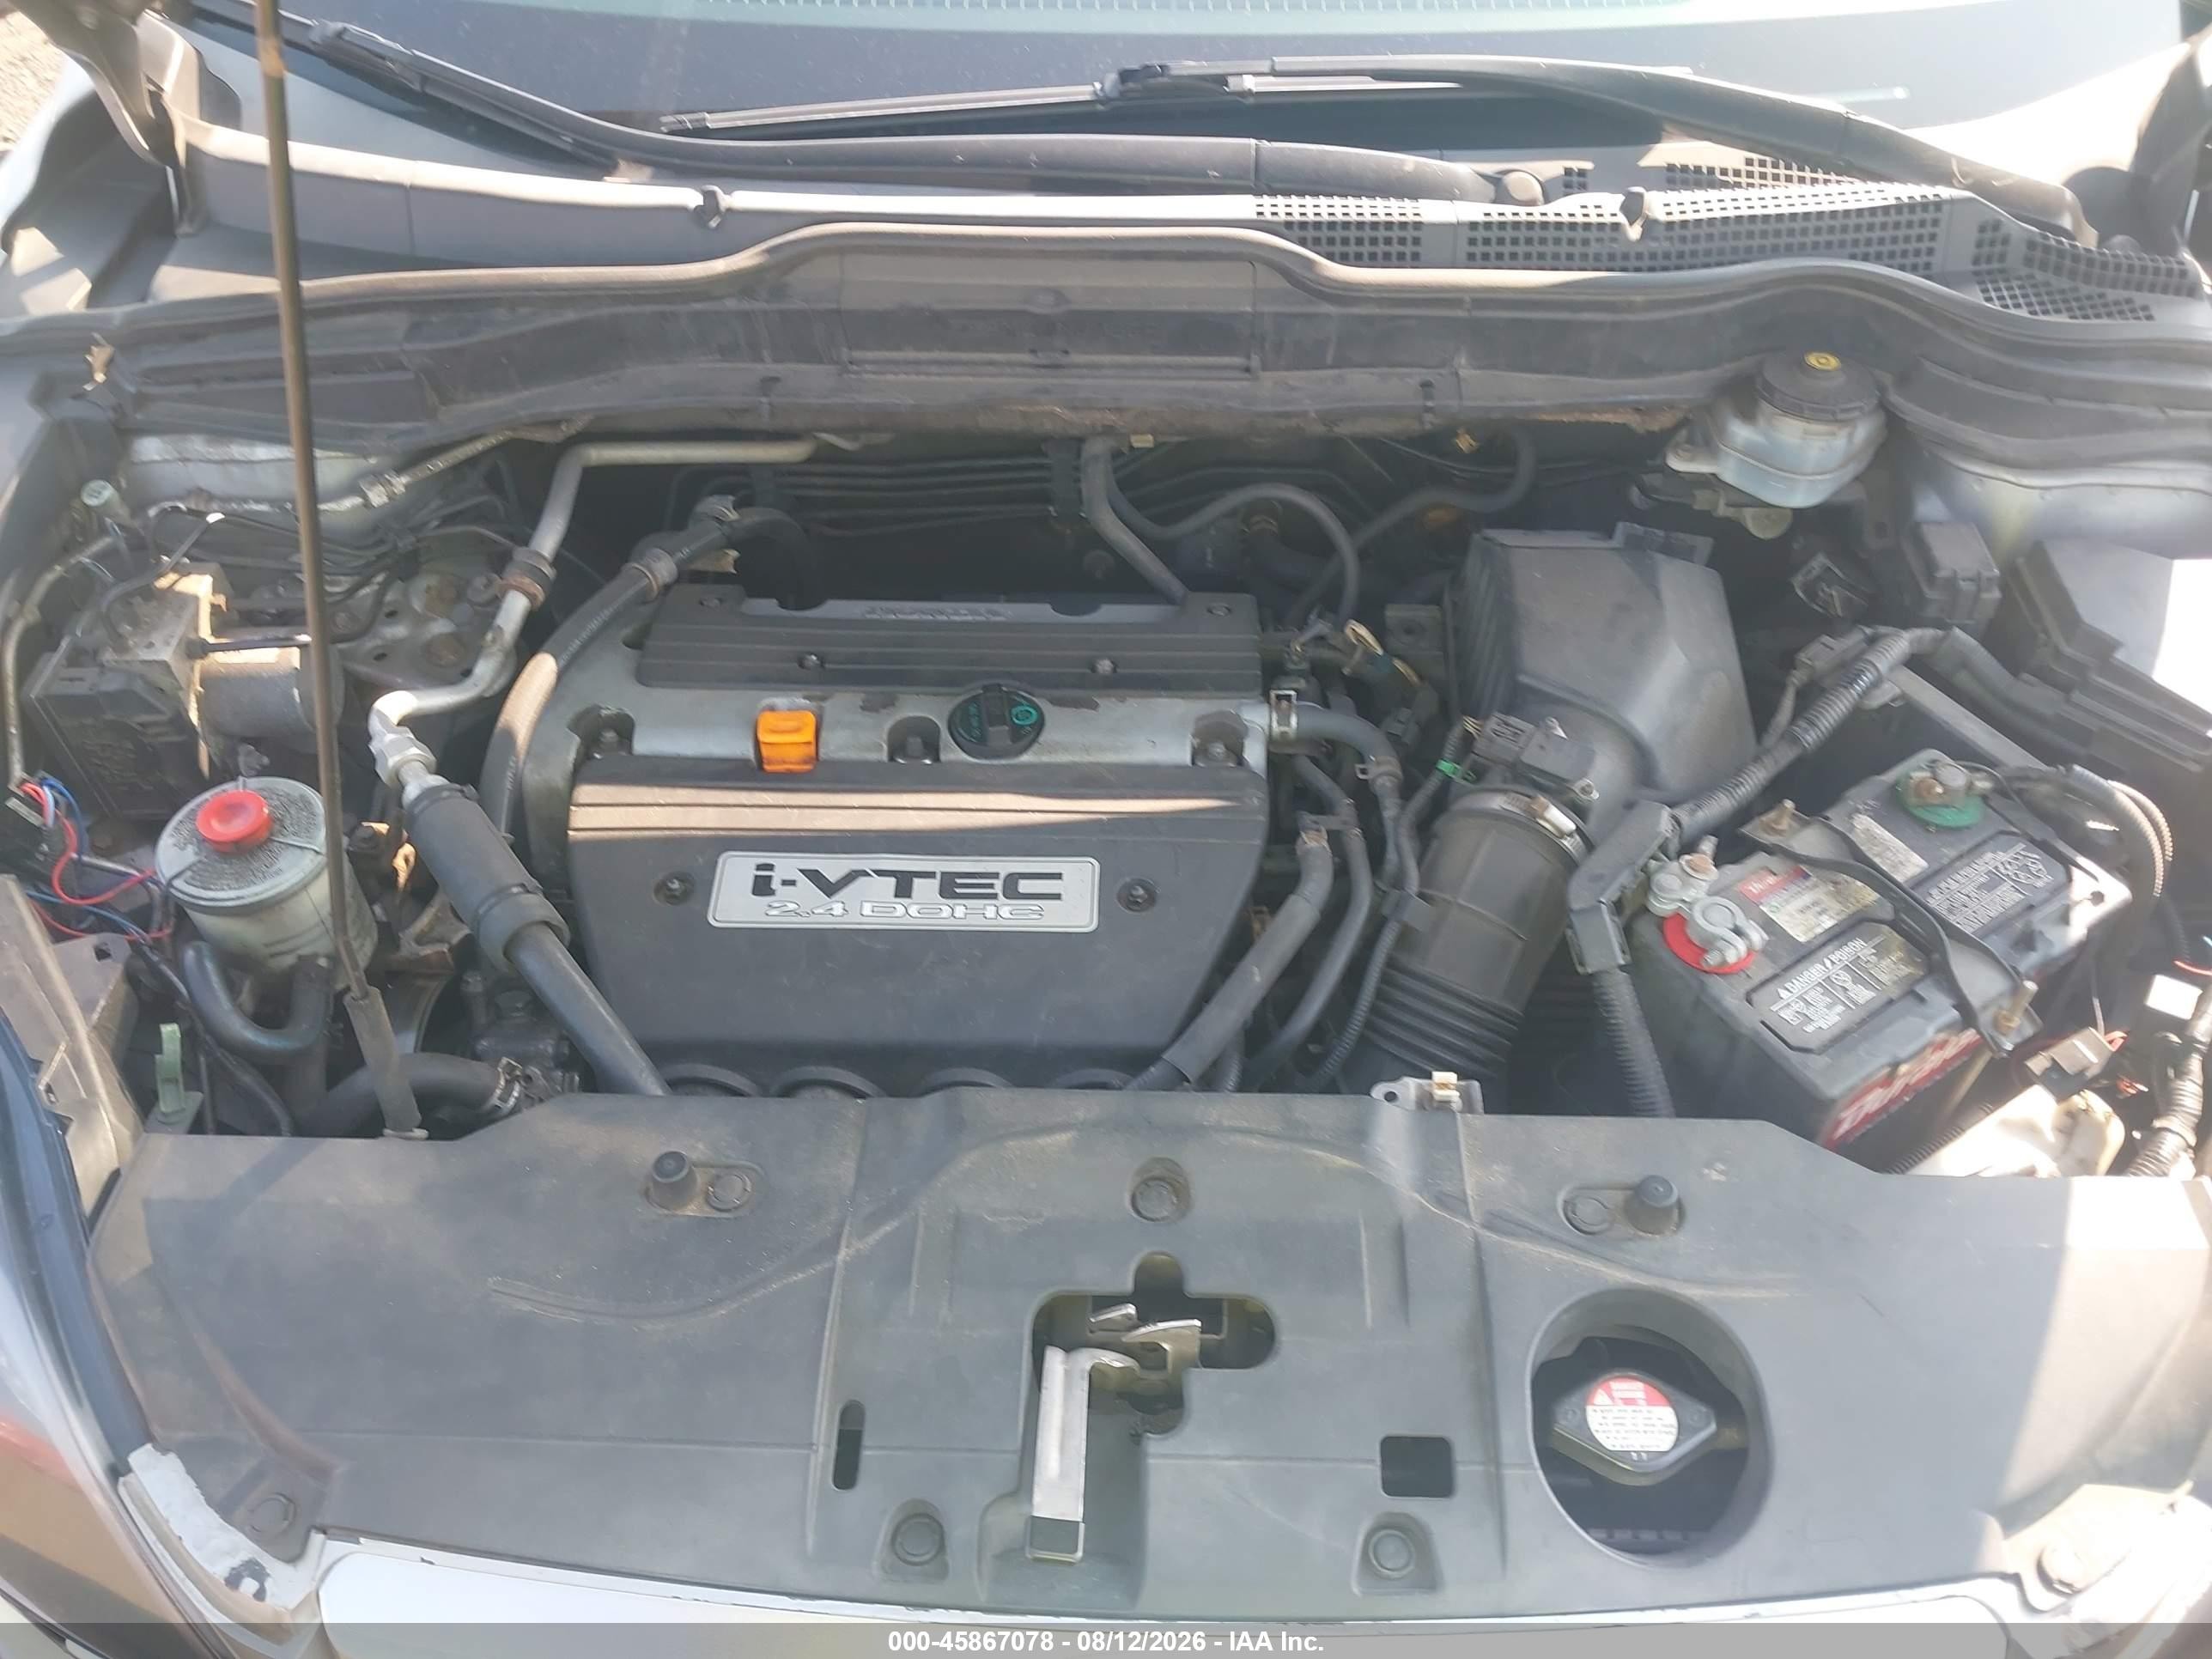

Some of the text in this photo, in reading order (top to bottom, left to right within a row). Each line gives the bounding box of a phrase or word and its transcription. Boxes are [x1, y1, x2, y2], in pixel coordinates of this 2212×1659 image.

[750, 861, 1063, 901] i-VTEC
[764, 900, 1046, 921] 2.4 DOHC
